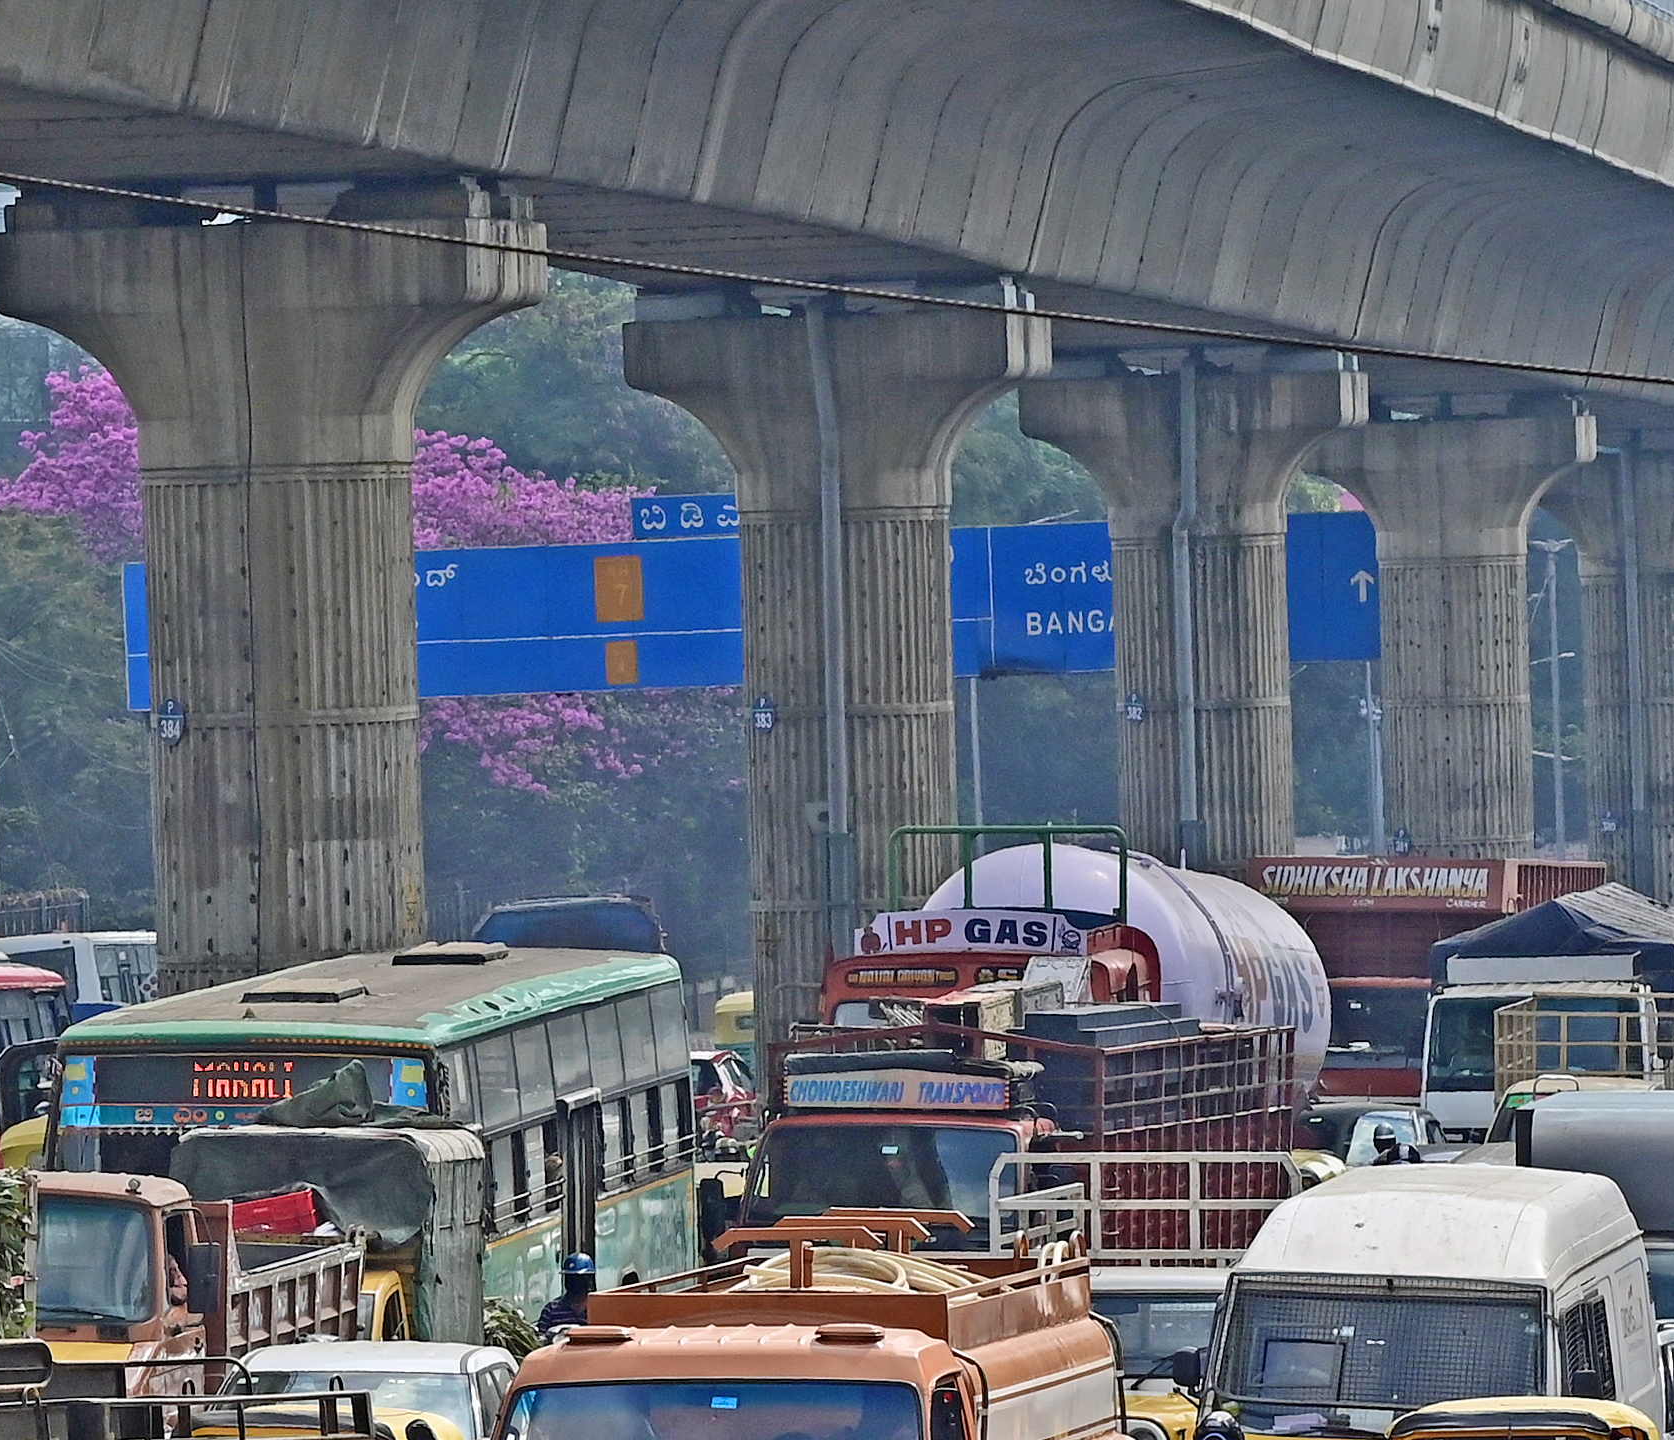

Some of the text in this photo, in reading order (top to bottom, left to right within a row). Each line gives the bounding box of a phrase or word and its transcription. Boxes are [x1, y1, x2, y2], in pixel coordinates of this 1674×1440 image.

[1026, 609, 1114, 636] BANG
[754, 712, 773, 729] 383
[1126, 705, 1143, 721] 382
[160, 720, 181, 739] 384
[1259, 865, 1489, 898] SIDHIKSHA LAKSHANYA
[895, 918, 1048, 948] HP GAS
